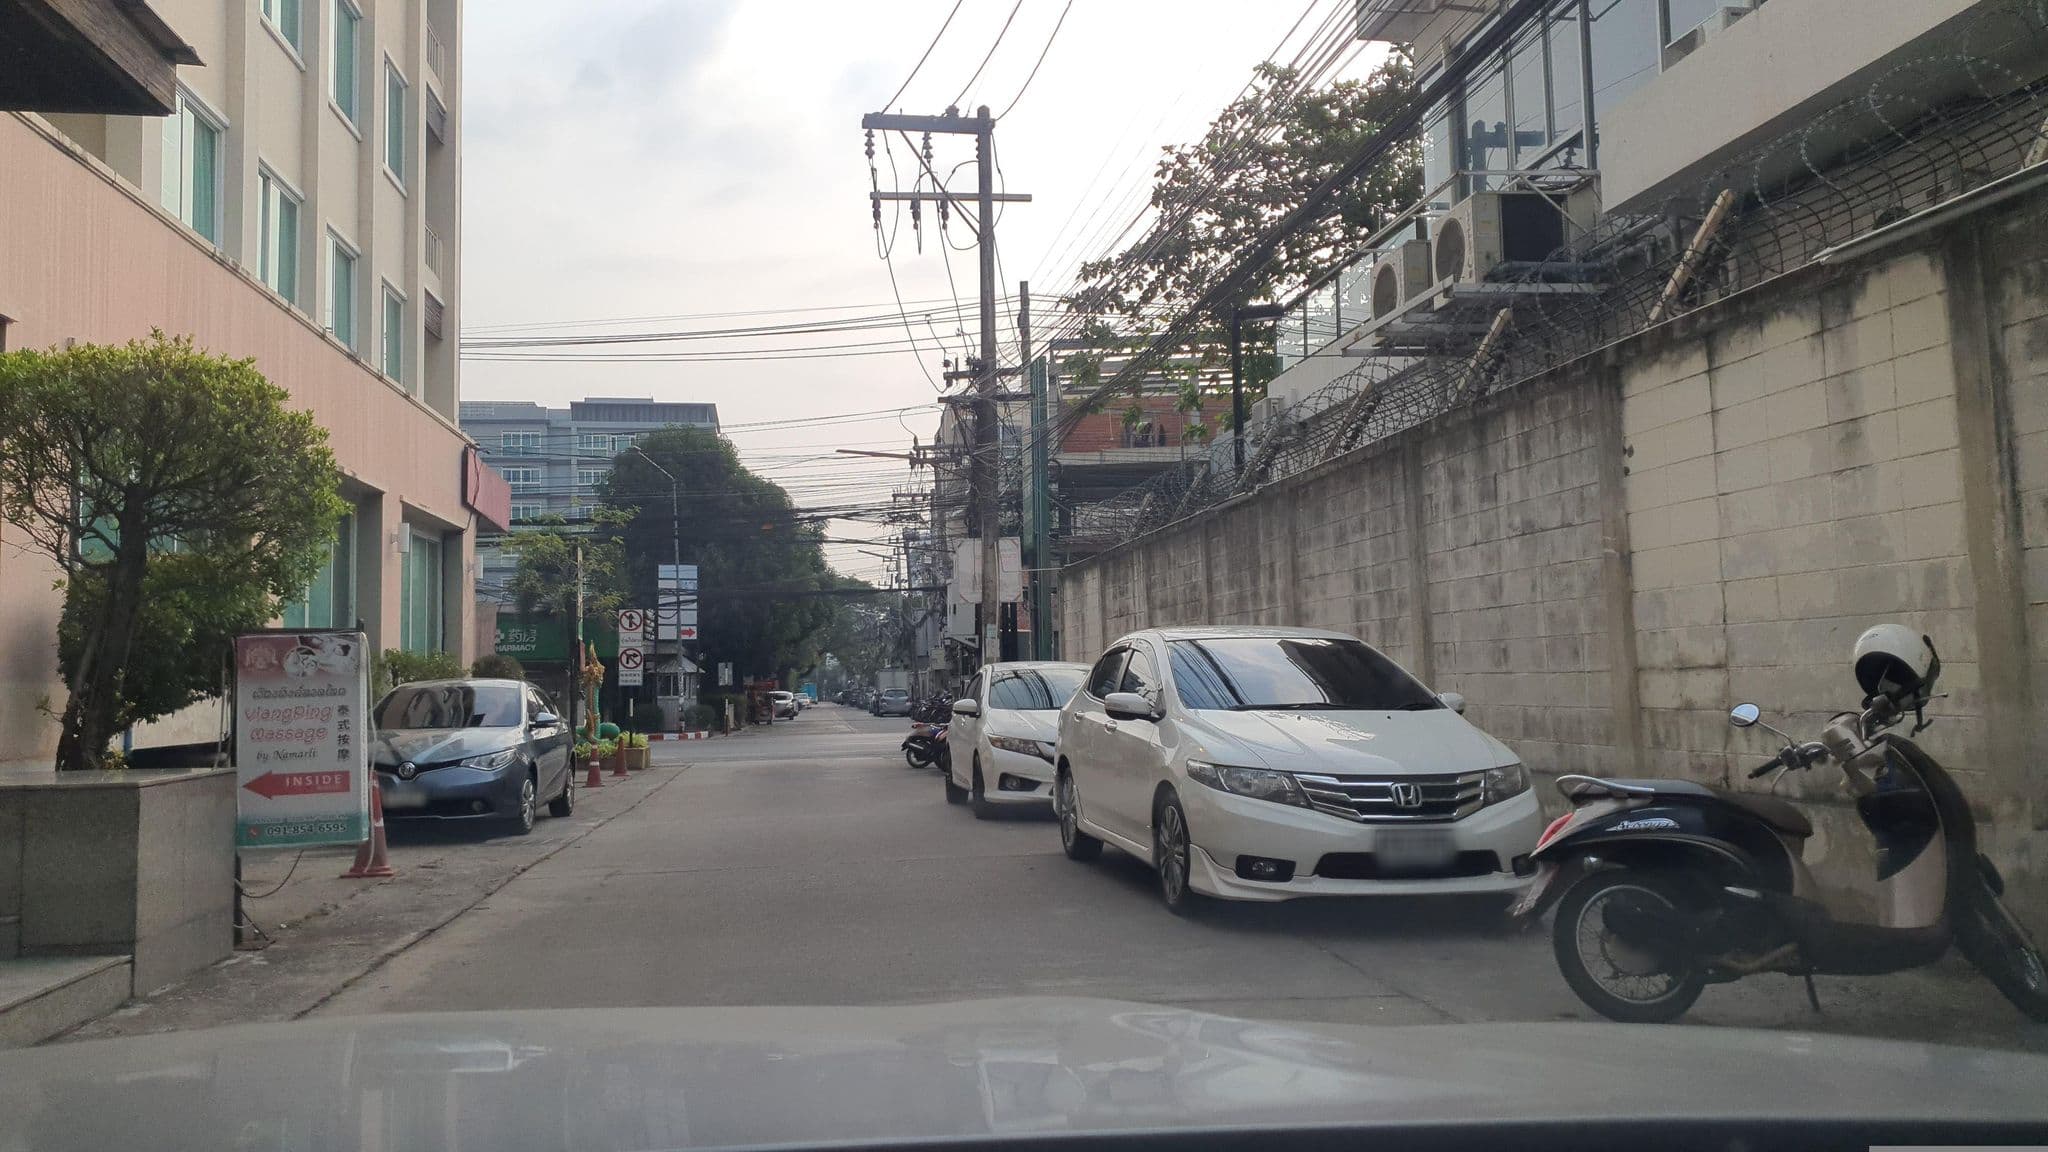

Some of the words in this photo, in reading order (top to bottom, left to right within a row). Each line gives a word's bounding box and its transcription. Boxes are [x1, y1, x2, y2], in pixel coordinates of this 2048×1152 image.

[495, 644, 537, 652] HARMACY
[250, 727, 328, 744] Massage
[285, 774, 343, 787] INSIDE
